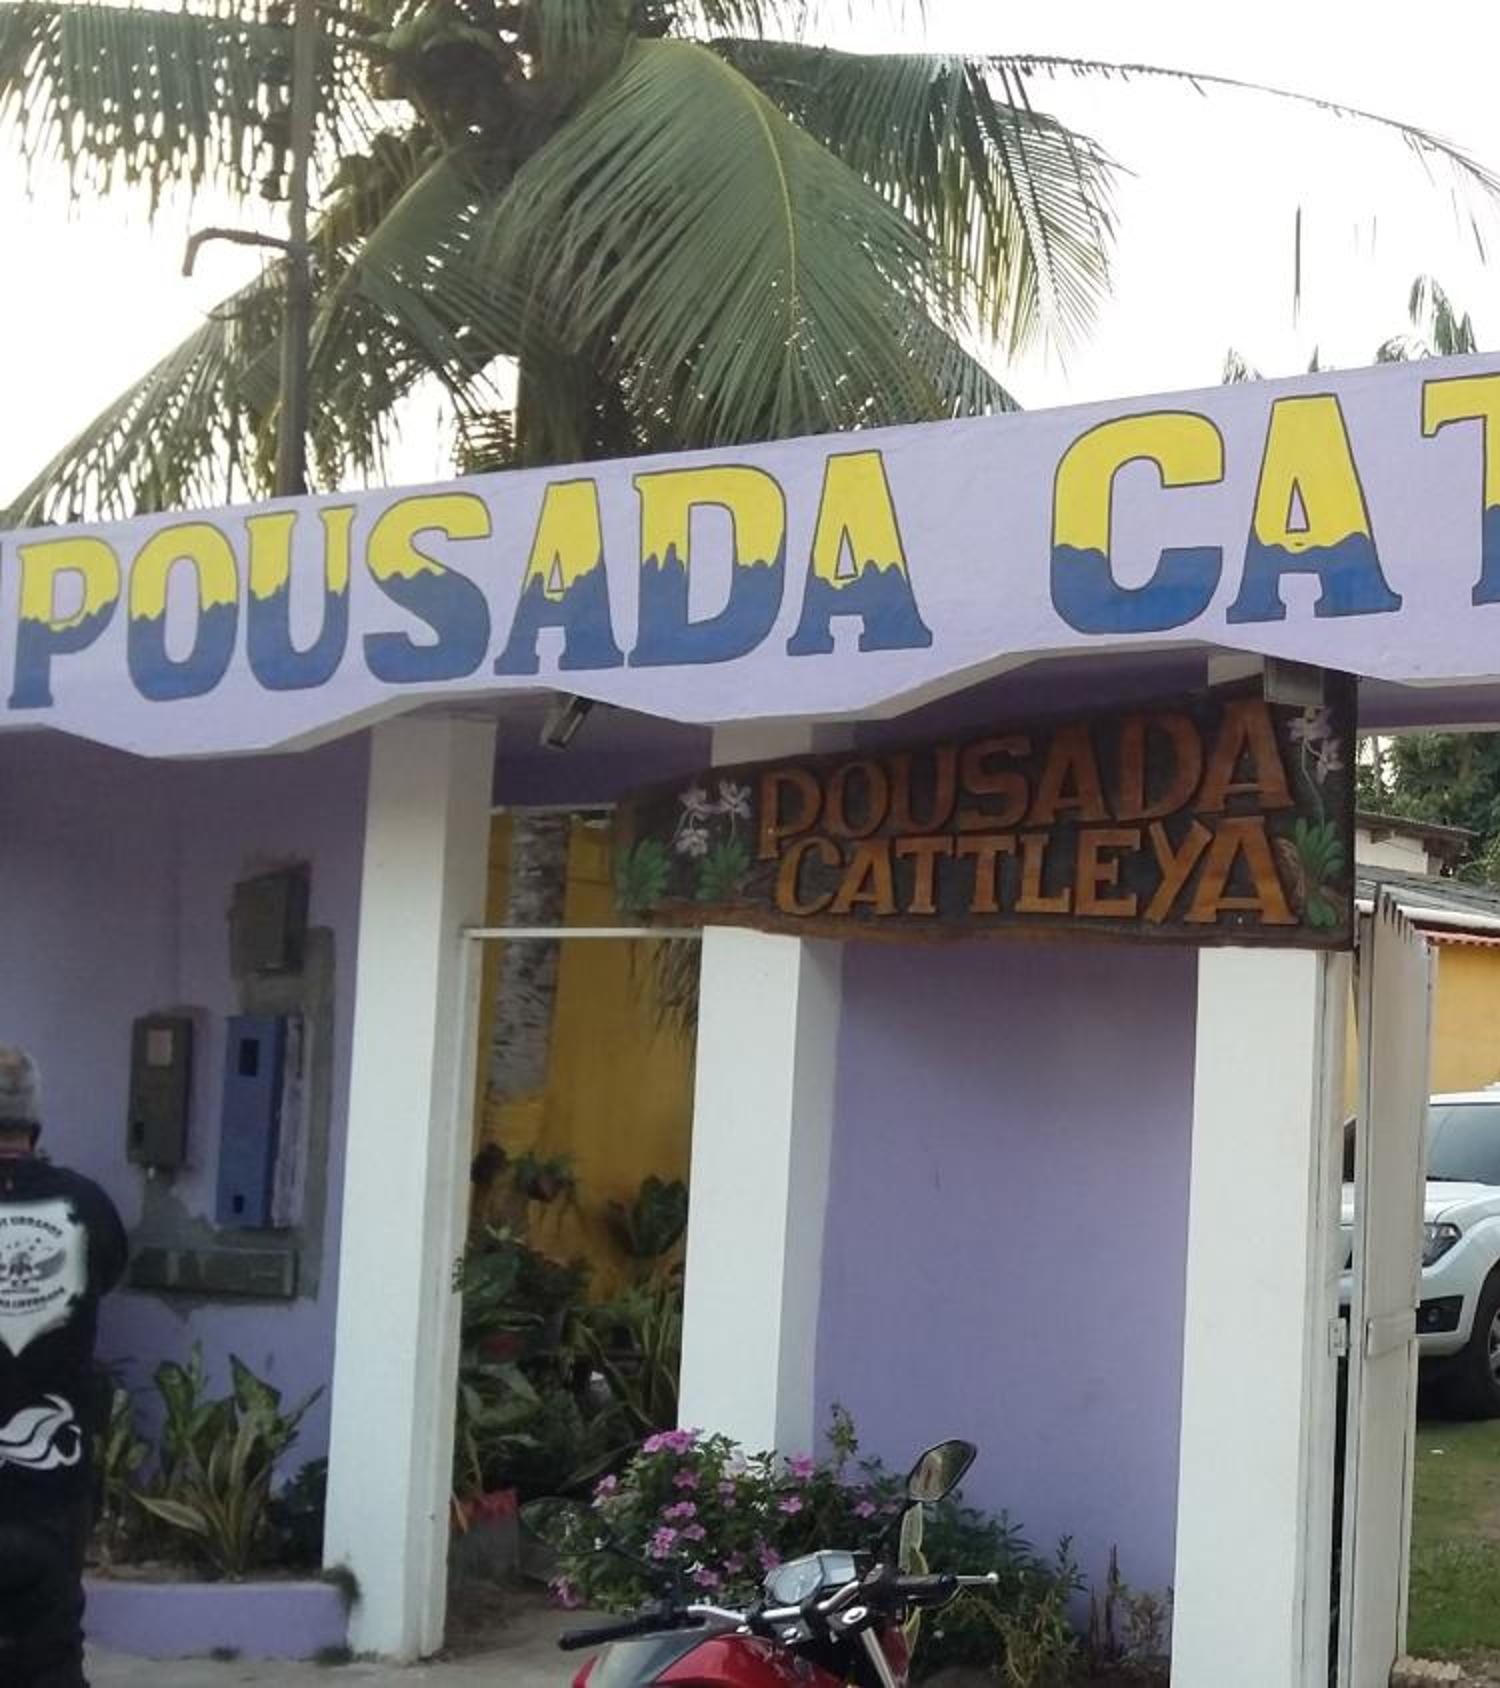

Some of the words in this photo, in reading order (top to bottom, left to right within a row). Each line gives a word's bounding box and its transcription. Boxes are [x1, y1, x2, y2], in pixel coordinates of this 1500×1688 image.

[6, 449, 934, 710] POUSADA
[756, 700, 1296, 860] POUSADA
[773, 814, 1299, 926] CATTLEYA
